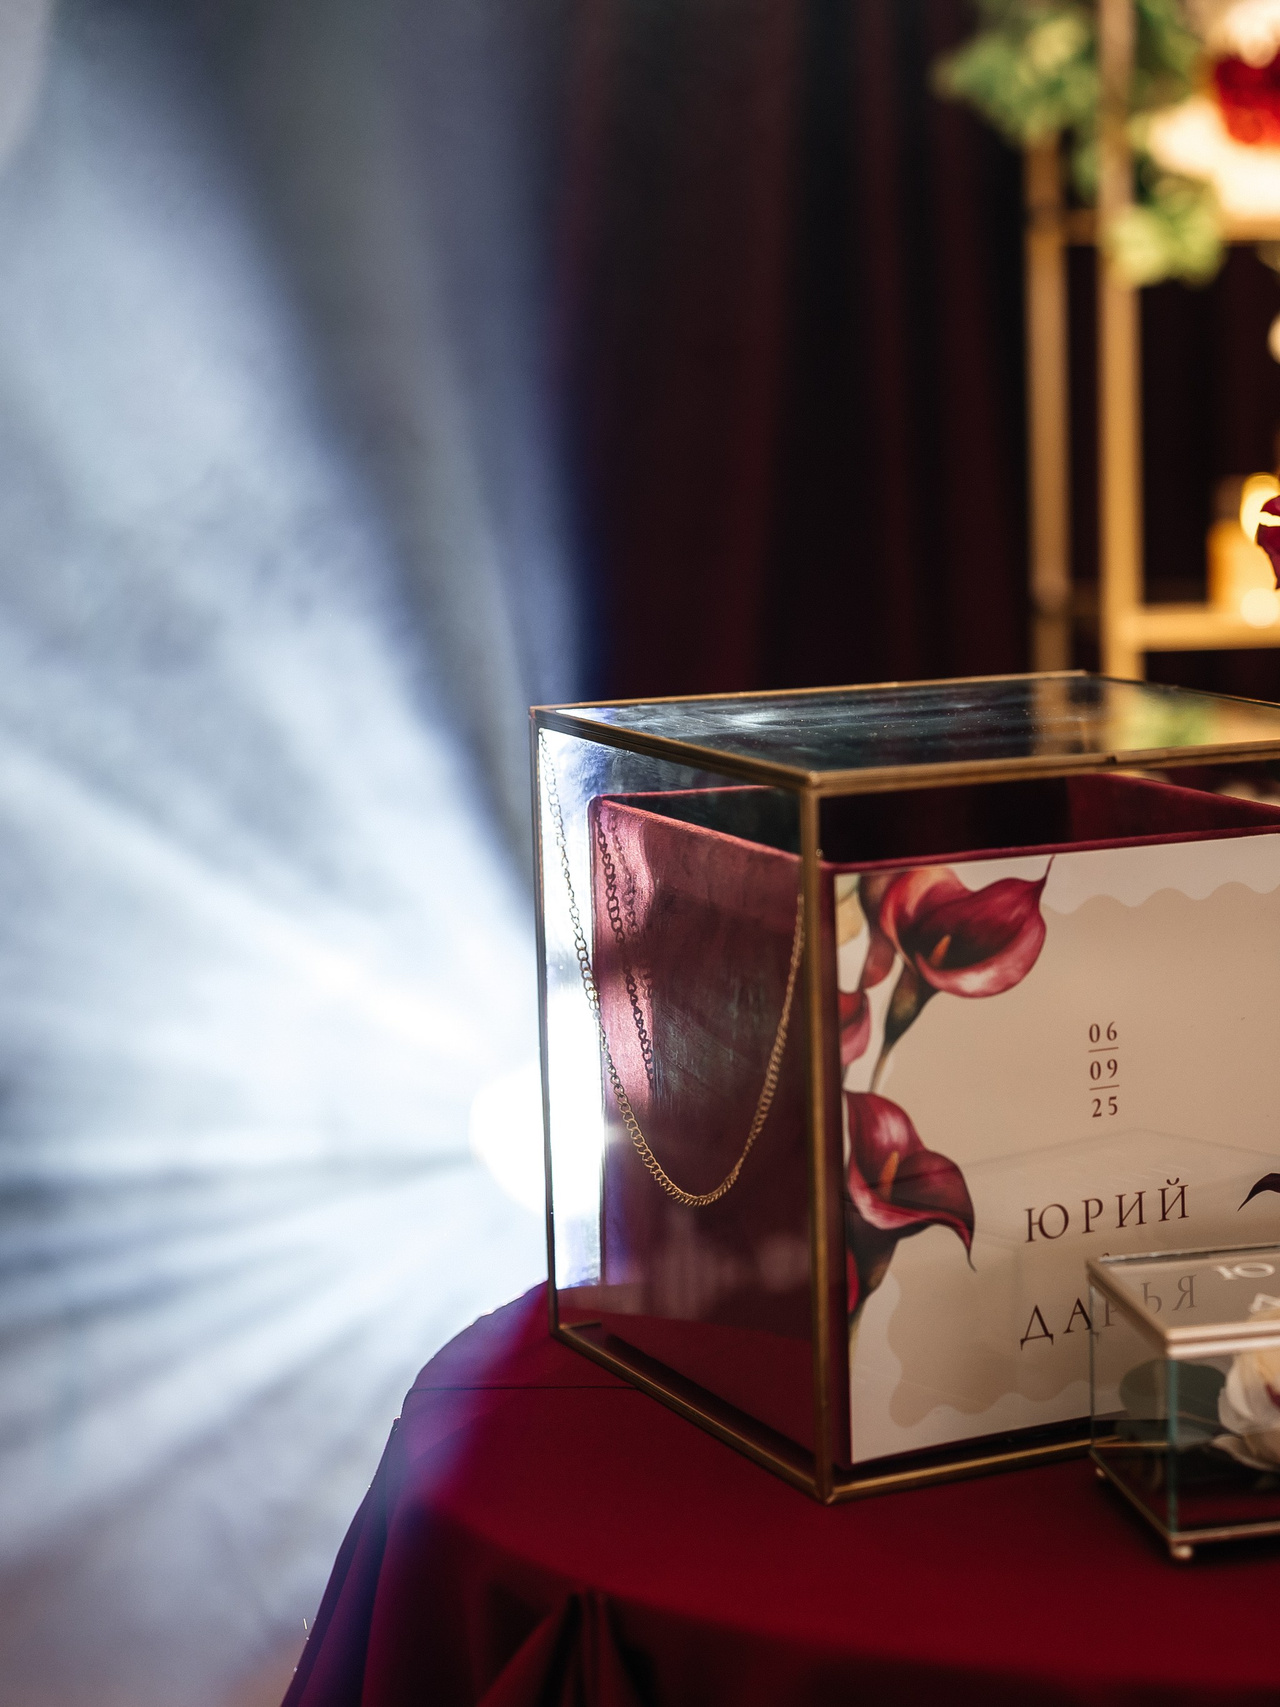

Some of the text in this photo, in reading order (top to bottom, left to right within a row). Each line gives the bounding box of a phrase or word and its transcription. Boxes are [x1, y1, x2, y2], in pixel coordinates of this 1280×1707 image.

[1088, 1021, 1118, 1043] 06
[1089, 1058, 1118, 1081] 09
[1091, 1095, 1119, 1118] 25
[1024, 1176, 1190, 1244] ЮРИЙ
